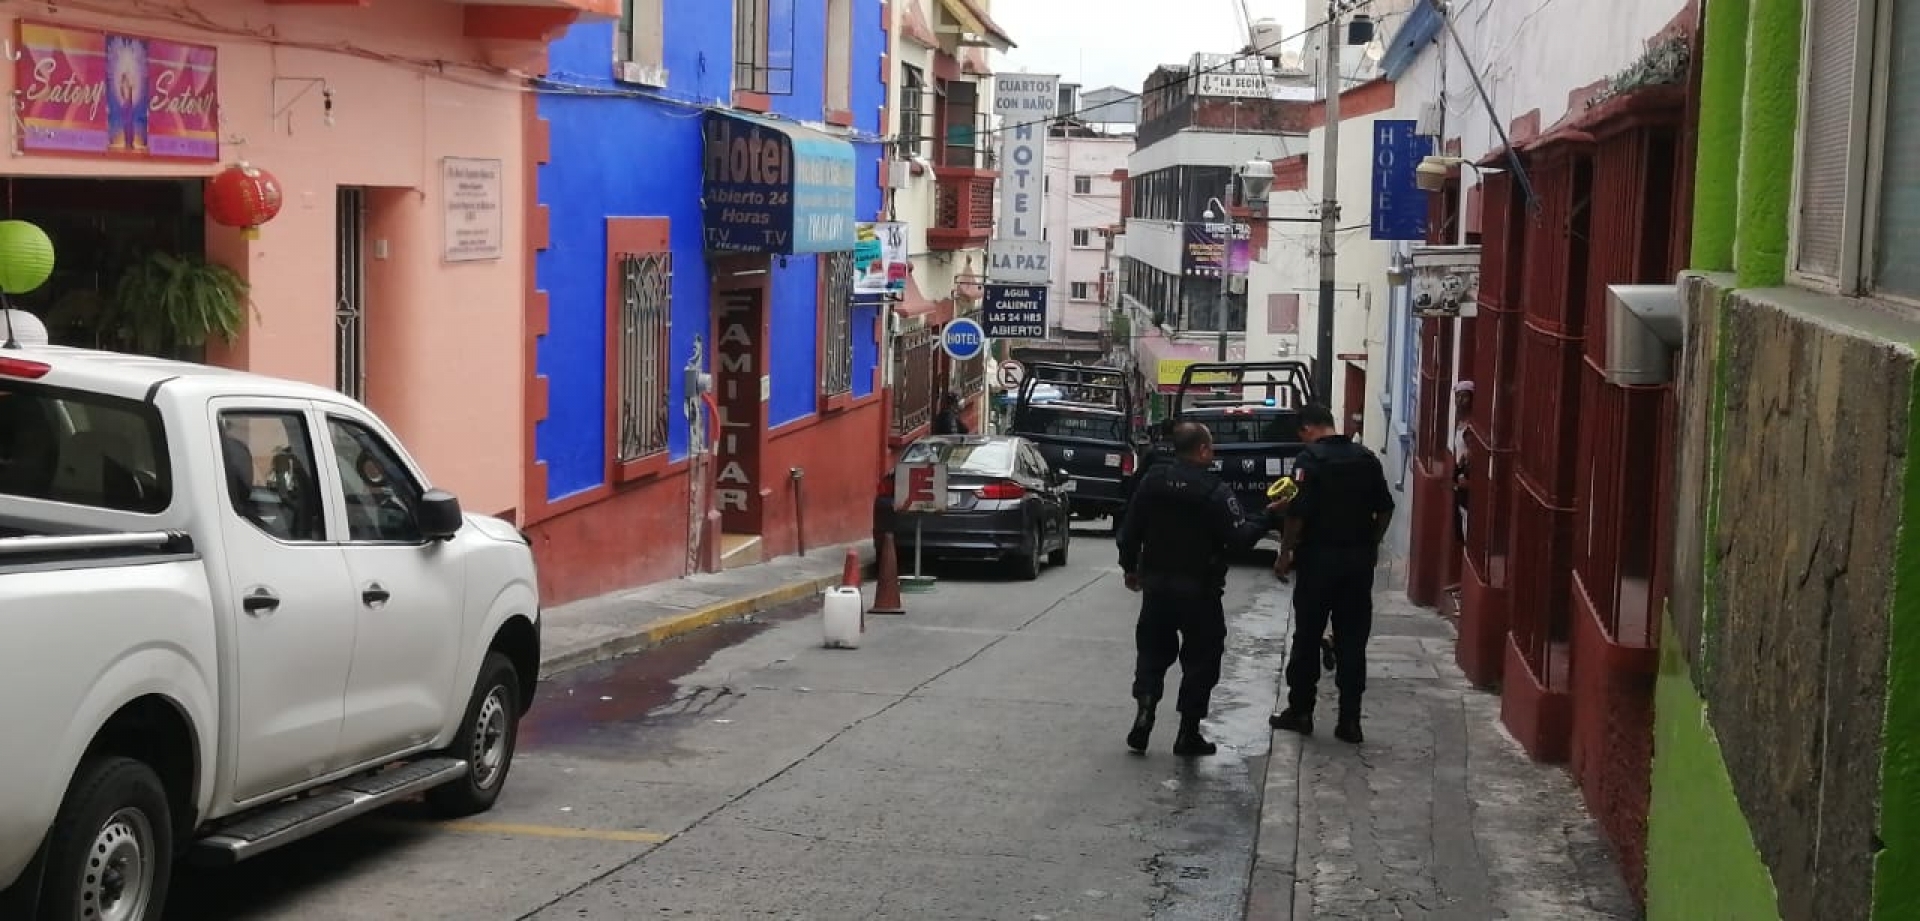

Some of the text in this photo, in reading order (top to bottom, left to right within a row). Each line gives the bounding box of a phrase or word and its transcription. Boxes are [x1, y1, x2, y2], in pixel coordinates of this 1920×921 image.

[27, 58, 106, 120] Satory
[999, 80, 1051, 93] CUARTOS
[996, 95, 1054, 110] CON BAÑO
[706, 118, 789, 185] Hotel
[1013, 120, 1033, 237] HOTEL
[1379, 126, 1394, 232] HOTEL
[707, 187, 764, 205] Abierto
[768, 191, 788, 205] 24
[721, 208, 769, 224] Horas
[992, 253, 1047, 270] LA PAZ
[1004, 289, 1029, 298] AGUA
[995, 301, 1038, 310] CALIENTE
[989, 313, 1041, 321] LAS 24 HRS
[947, 333, 979, 345] HOTEL
[990, 326, 1042, 337] ABIERTO
[717, 294, 752, 511] FAMILIAR
